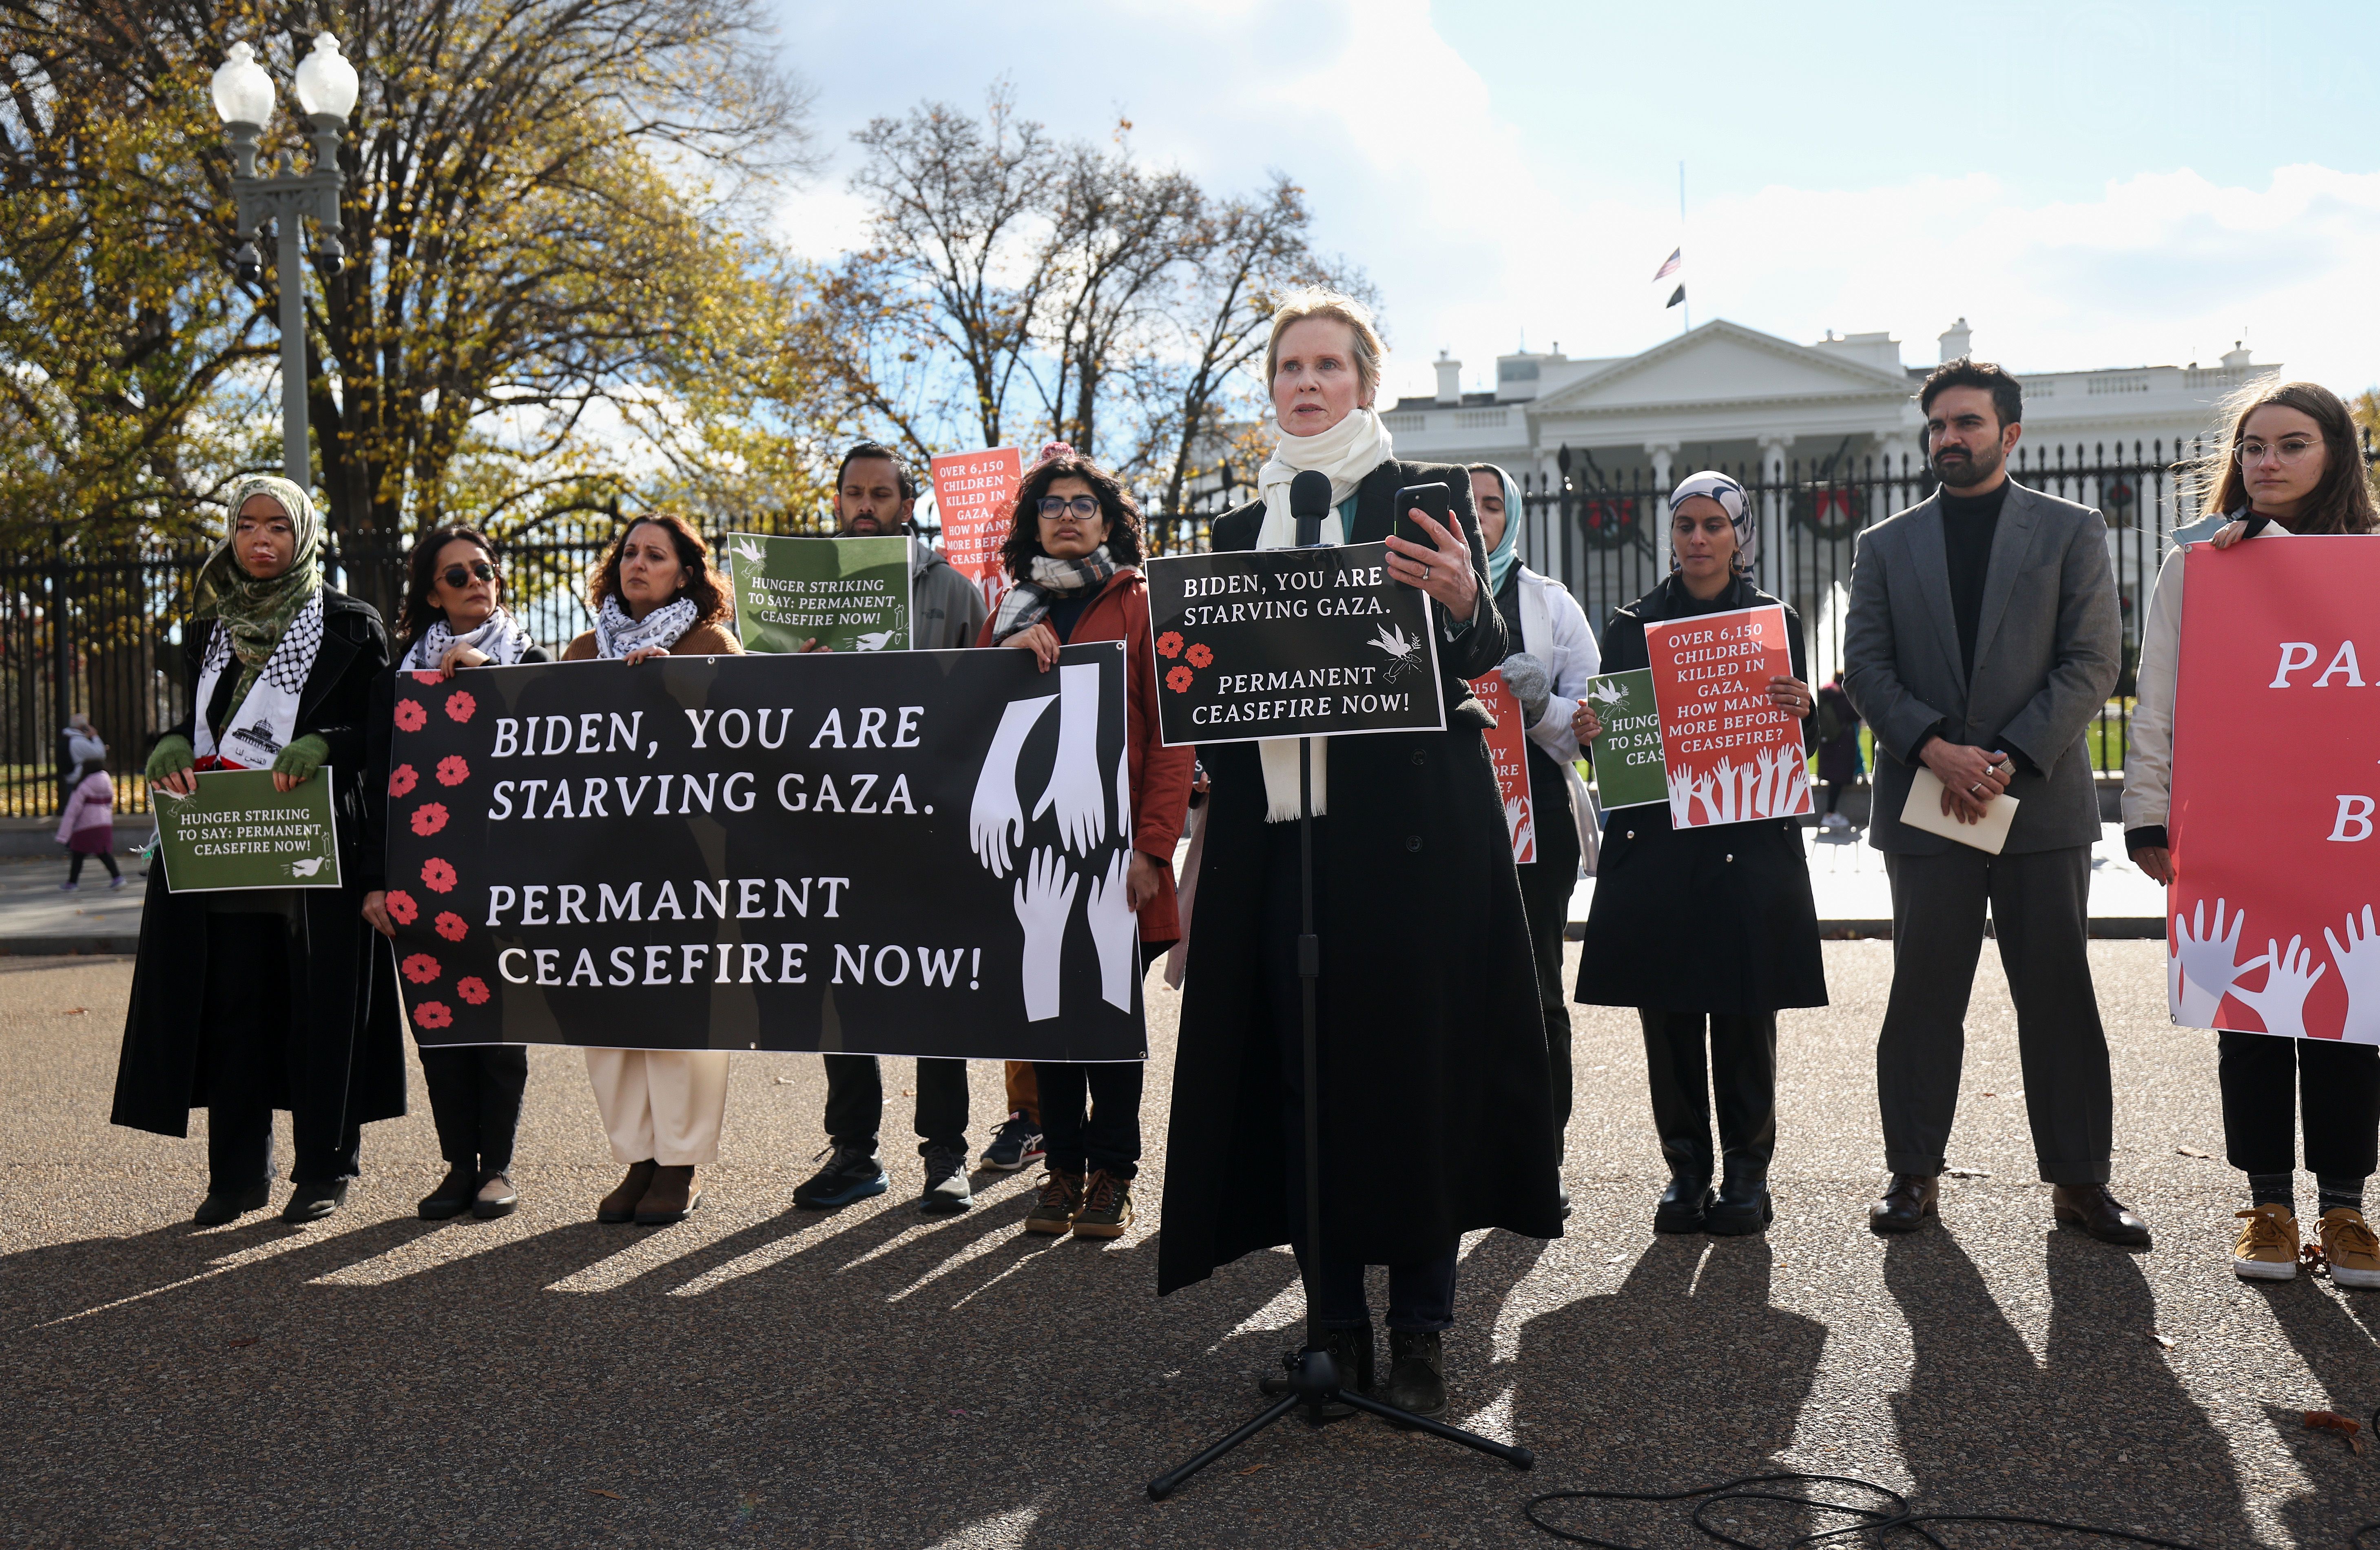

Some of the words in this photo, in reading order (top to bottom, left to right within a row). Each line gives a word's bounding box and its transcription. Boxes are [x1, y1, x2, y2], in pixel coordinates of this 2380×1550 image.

[939, 465, 966, 478] OVER
[970, 460, 1004, 475] 6,150
[943, 475, 1004, 492] CHILDREN
[946, 493, 986, 507] KILLED
[990, 489, 1005, 502] IN
[957, 507, 994, 520] GAZA,
[948, 524, 970, 536] HOW
[947, 539, 971, 550] MORE
[974, 535, 1006, 548] BEFO
[751, 576, 805, 592] HUNGER
[809, 579, 884, 593] STRIKING
[1183, 574, 1266, 598] BIDEN,
[1274, 571, 1324, 591] YOU
[1334, 566, 1382, 587] ARE
[748, 592, 764, 605] TO
[767, 594, 794, 608] SAY:
[798, 596, 895, 610] PERMANENT
[761, 610, 834, 626] CEASEFIRE
[838, 613, 880, 624] NOW!
[1184, 600, 1308, 626] STARVING
[1317, 596, 1390, 616] GAZA.
[1669, 630, 1714, 648] OVER
[1720, 623, 1762, 641] 6,150
[1674, 640, 1762, 665] CHILDREN
[1677, 662, 1738, 682] KILLED
[1745, 658, 1765, 672] IN
[2269, 640, 2380, 688] PA
[1218, 667, 1376, 695] PERMANENT
[1475, 682, 1498, 694] 150
[1698, 680, 1749, 697] GAZA,
[1192, 697, 1331, 724] CEASEFIRE
[1342, 693, 1409, 714] NOW!
[1677, 701, 1717, 718] HOW
[1612, 714, 1658, 732] HUNG
[1669, 719, 1717, 737] MORE
[1724, 710, 1789, 730] BEFORE
[491, 711, 658, 759] BIDEN,
[688, 707, 794, 749] YOU
[809, 706, 924, 748] ARE
[1681, 728, 1784, 753] CEASEFIRE?
[1608, 736, 1629, 750] TO
[488, 772, 756, 820] STARVING
[777, 773, 933, 815] GAZA.
[181, 811, 241, 825] HUNGER
[245, 808, 310, 822] STRIKING
[177, 829, 197, 841] TO
[201, 827, 232, 839] SAY:
[237, 824, 321, 838] PERMANENT
[194, 841, 270, 855] CEASEFIRE
[275, 840, 310, 852] NOW!
[485, 877, 849, 926] PERMANENT
[498, 943, 808, 986] CEASEFIRE
[831, 944, 981, 990] NOW!
